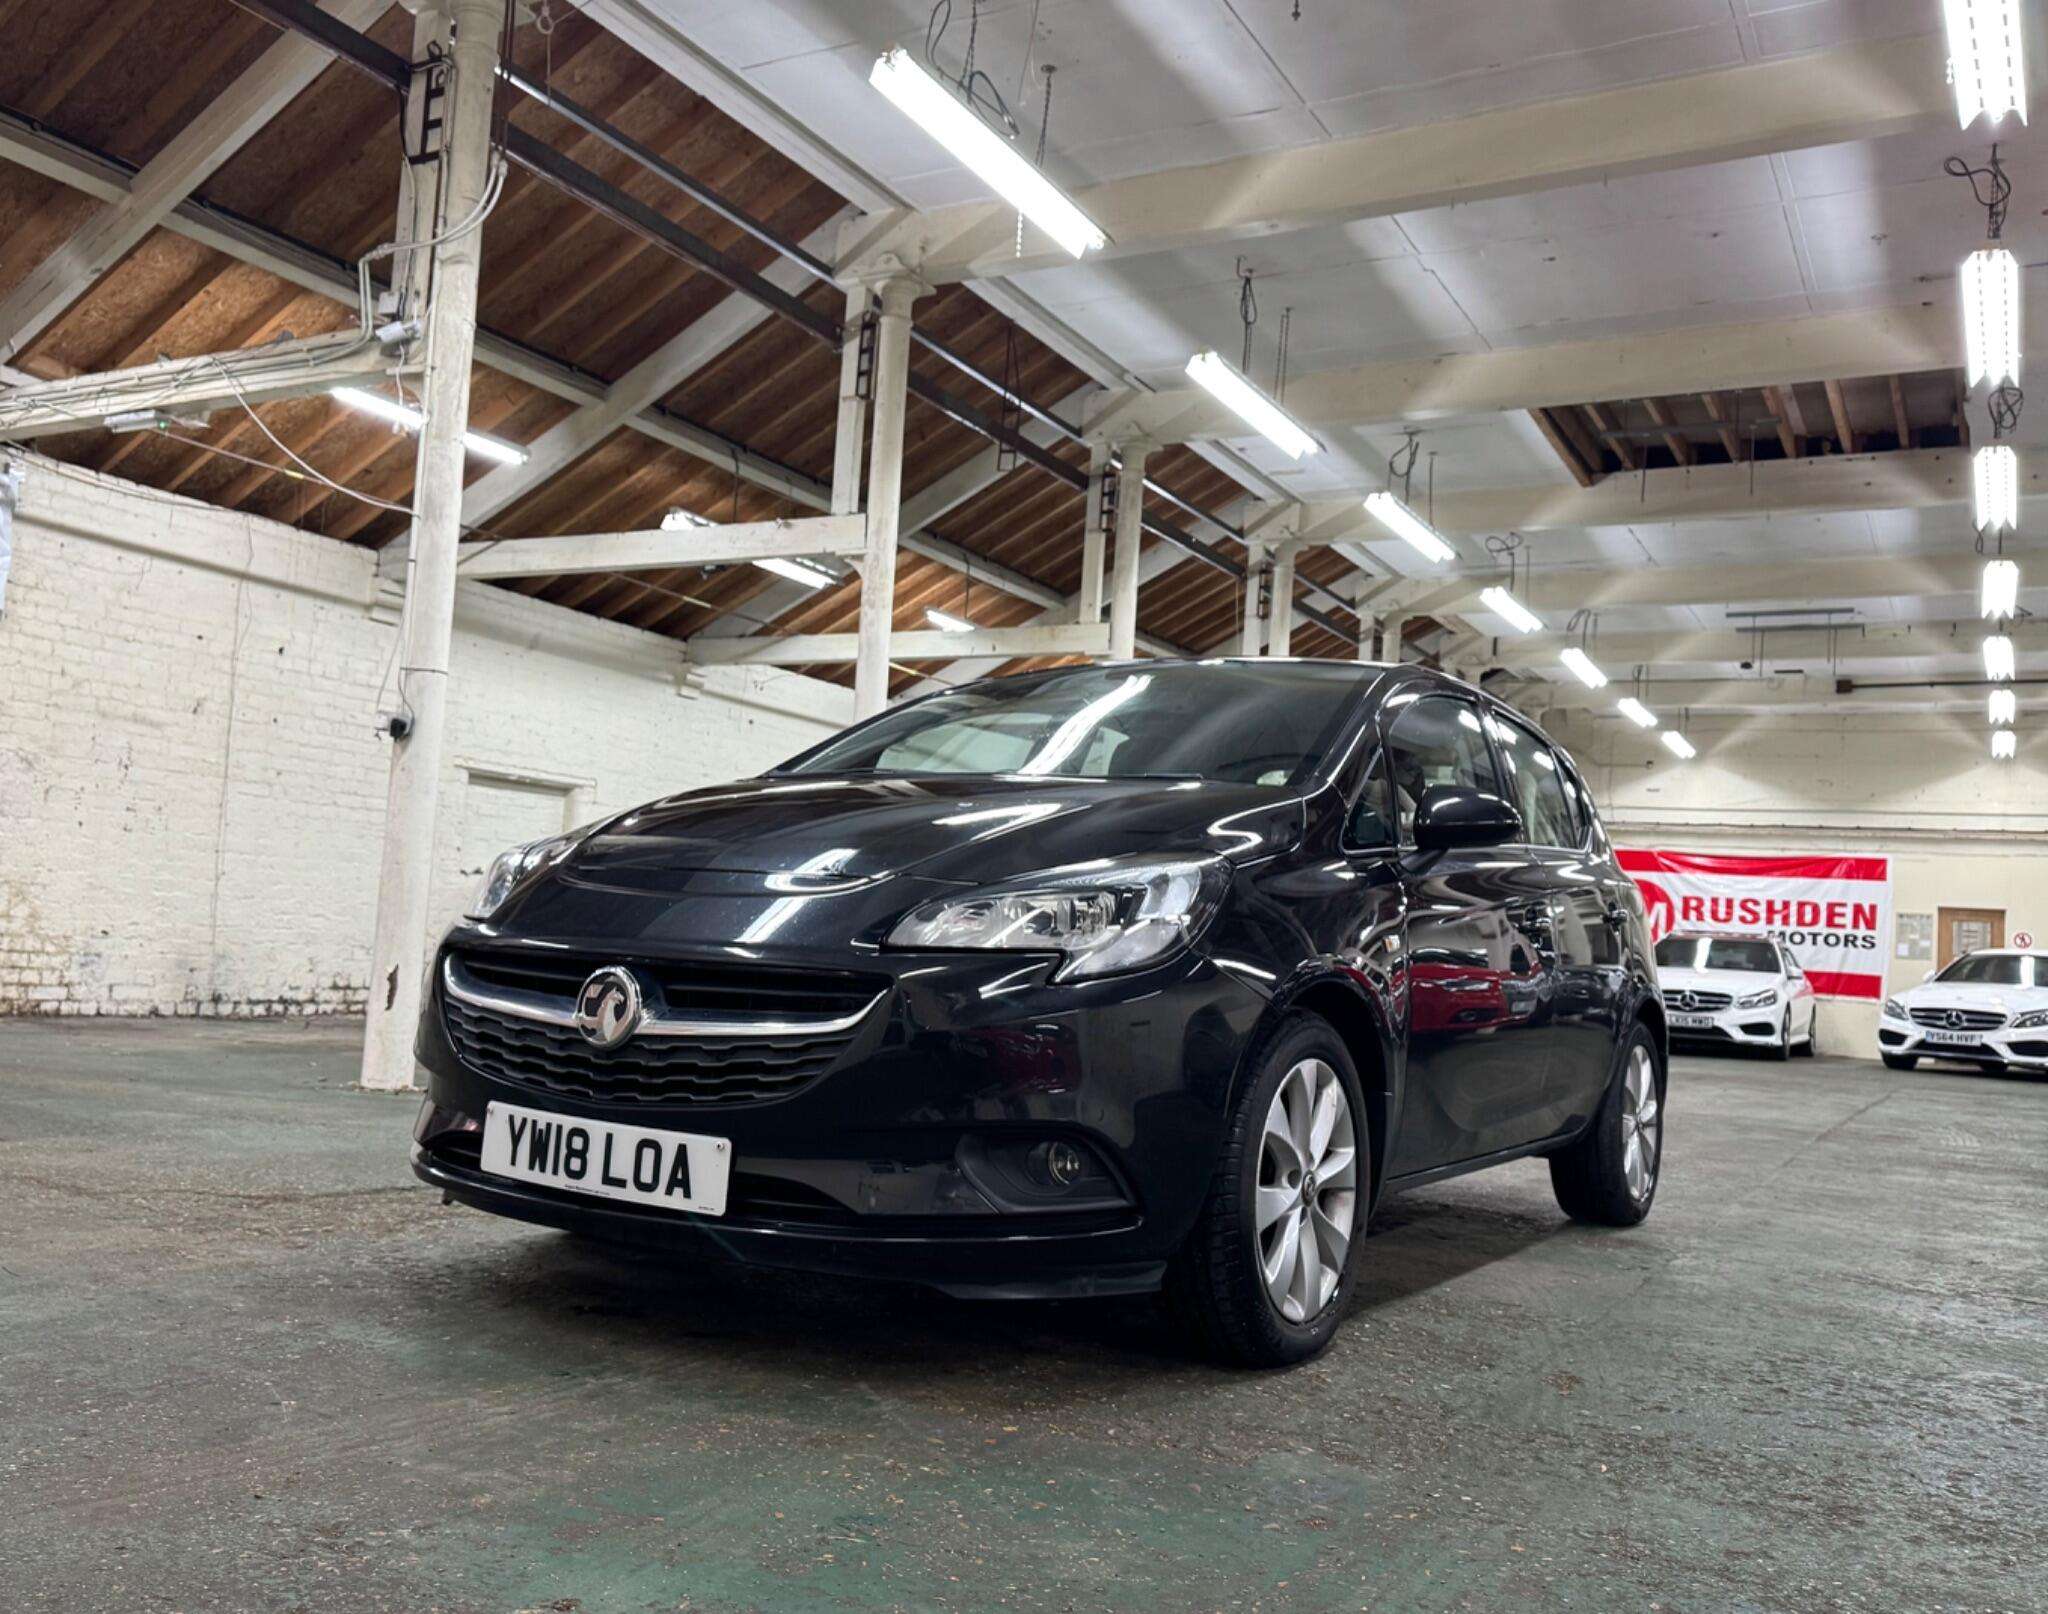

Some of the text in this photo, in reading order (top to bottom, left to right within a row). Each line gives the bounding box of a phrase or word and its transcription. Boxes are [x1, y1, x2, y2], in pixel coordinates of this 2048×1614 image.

[1681, 895, 1877, 930] RUSHDEN
[508, 1114, 692, 1199] YW18 LOA
